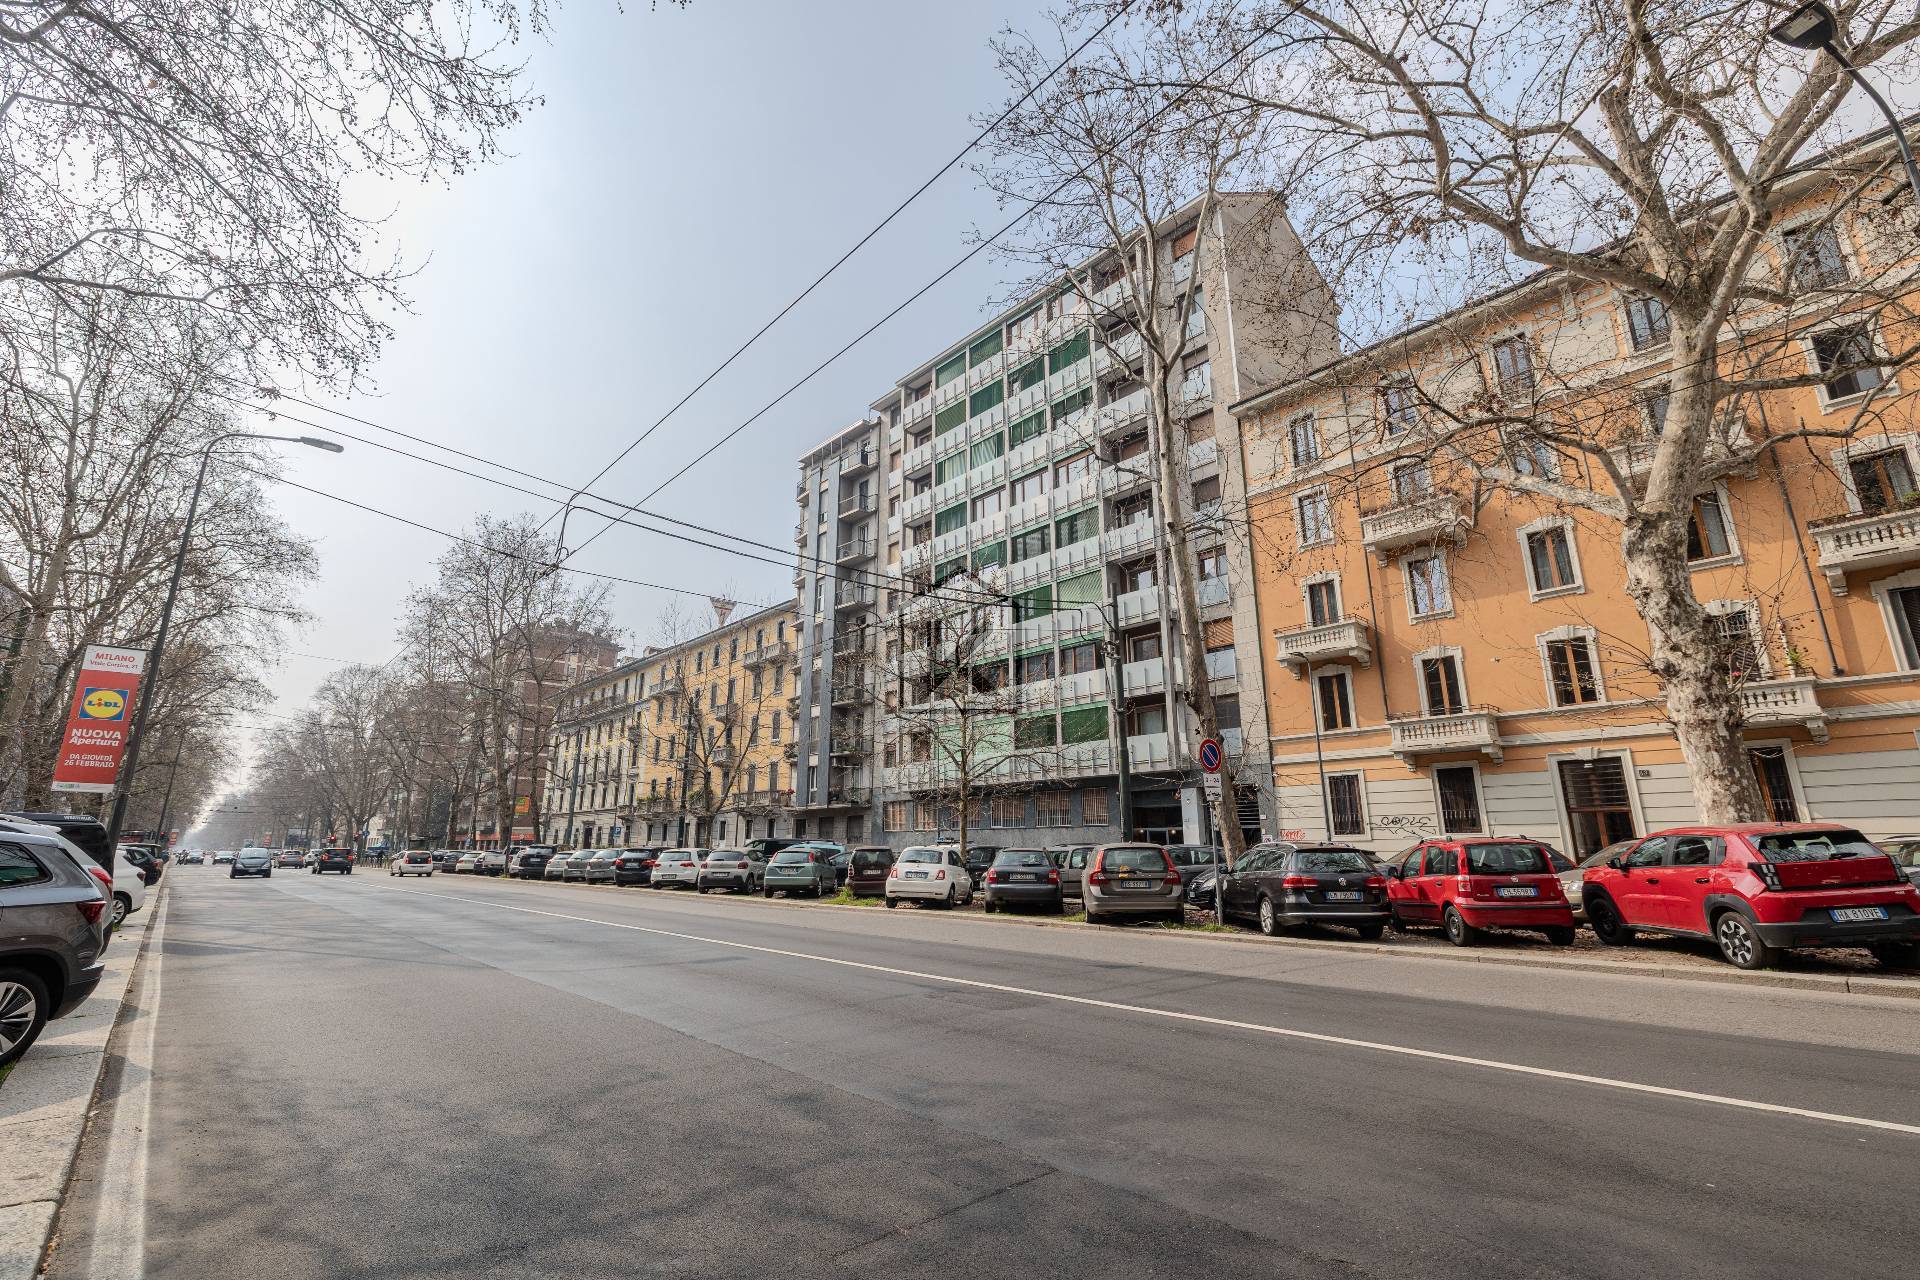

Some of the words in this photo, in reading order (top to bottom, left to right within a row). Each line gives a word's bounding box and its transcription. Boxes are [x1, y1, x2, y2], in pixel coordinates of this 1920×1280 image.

[95, 652, 135, 662] MILANO
[71, 728, 121, 739] NUOVA
[69, 736, 120, 747] Apertura
[75, 760, 115, 768] FEBBRAIO
[1837, 910, 1851, 920] HA
